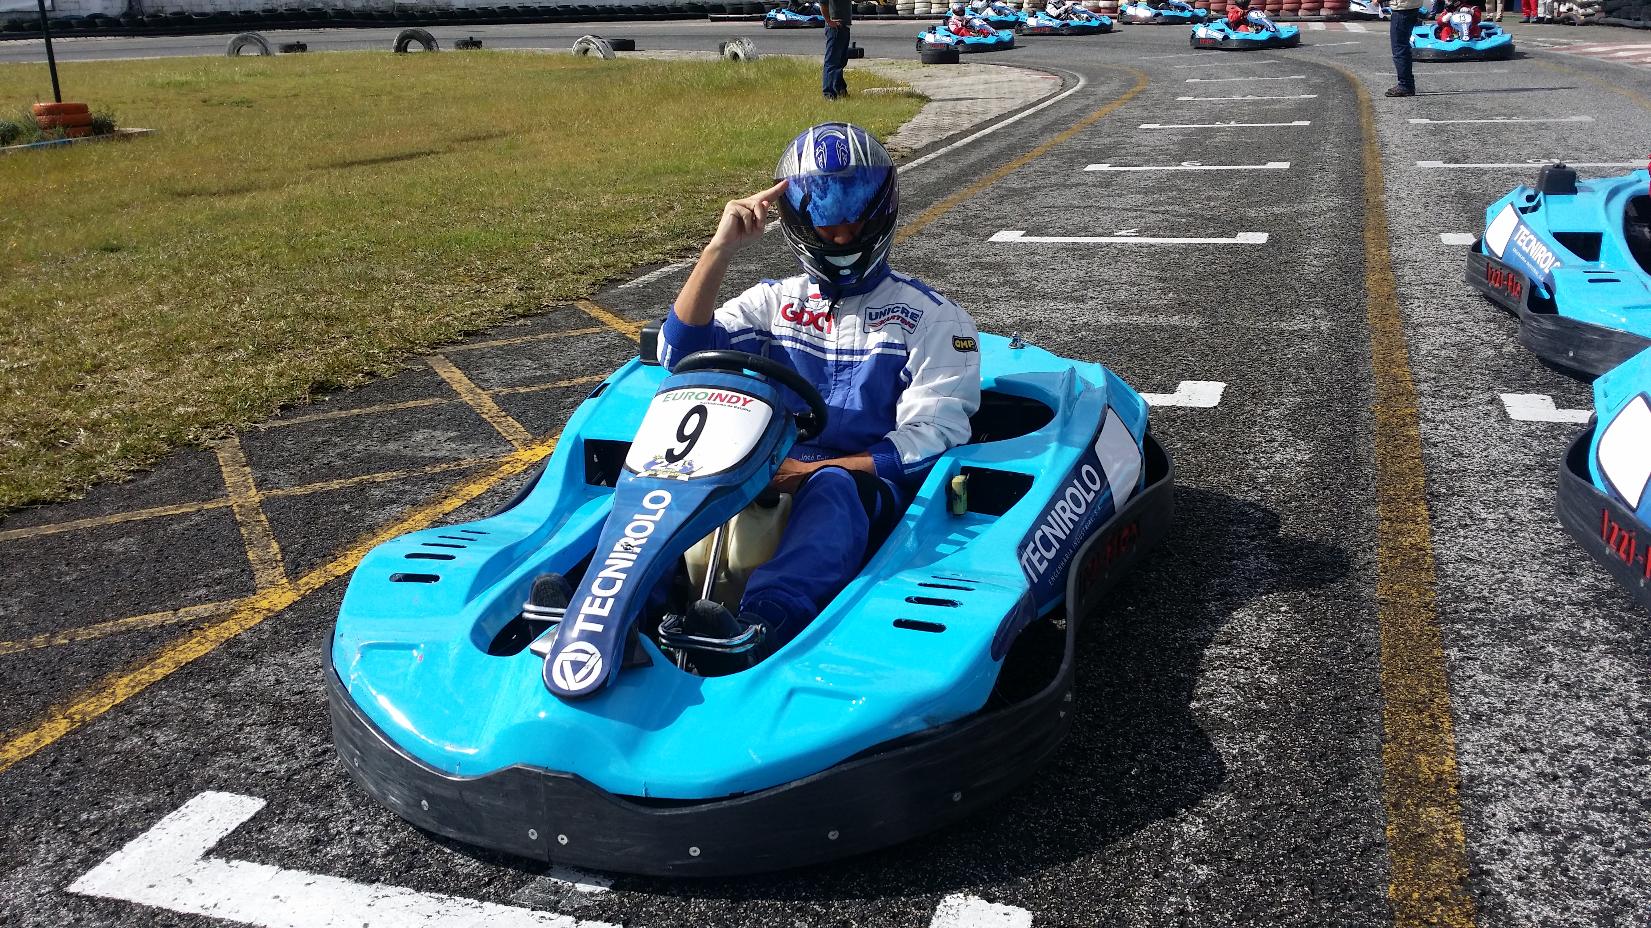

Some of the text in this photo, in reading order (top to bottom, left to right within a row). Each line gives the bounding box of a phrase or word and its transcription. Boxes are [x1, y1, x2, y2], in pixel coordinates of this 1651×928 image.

[869, 306, 919, 322] UNICRE
[955, 339, 973, 348] OMP
[665, 404, 708, 463] 9
[1020, 464, 1101, 584] TECNIROLO
[571, 489, 672, 638] TECNIROLO
